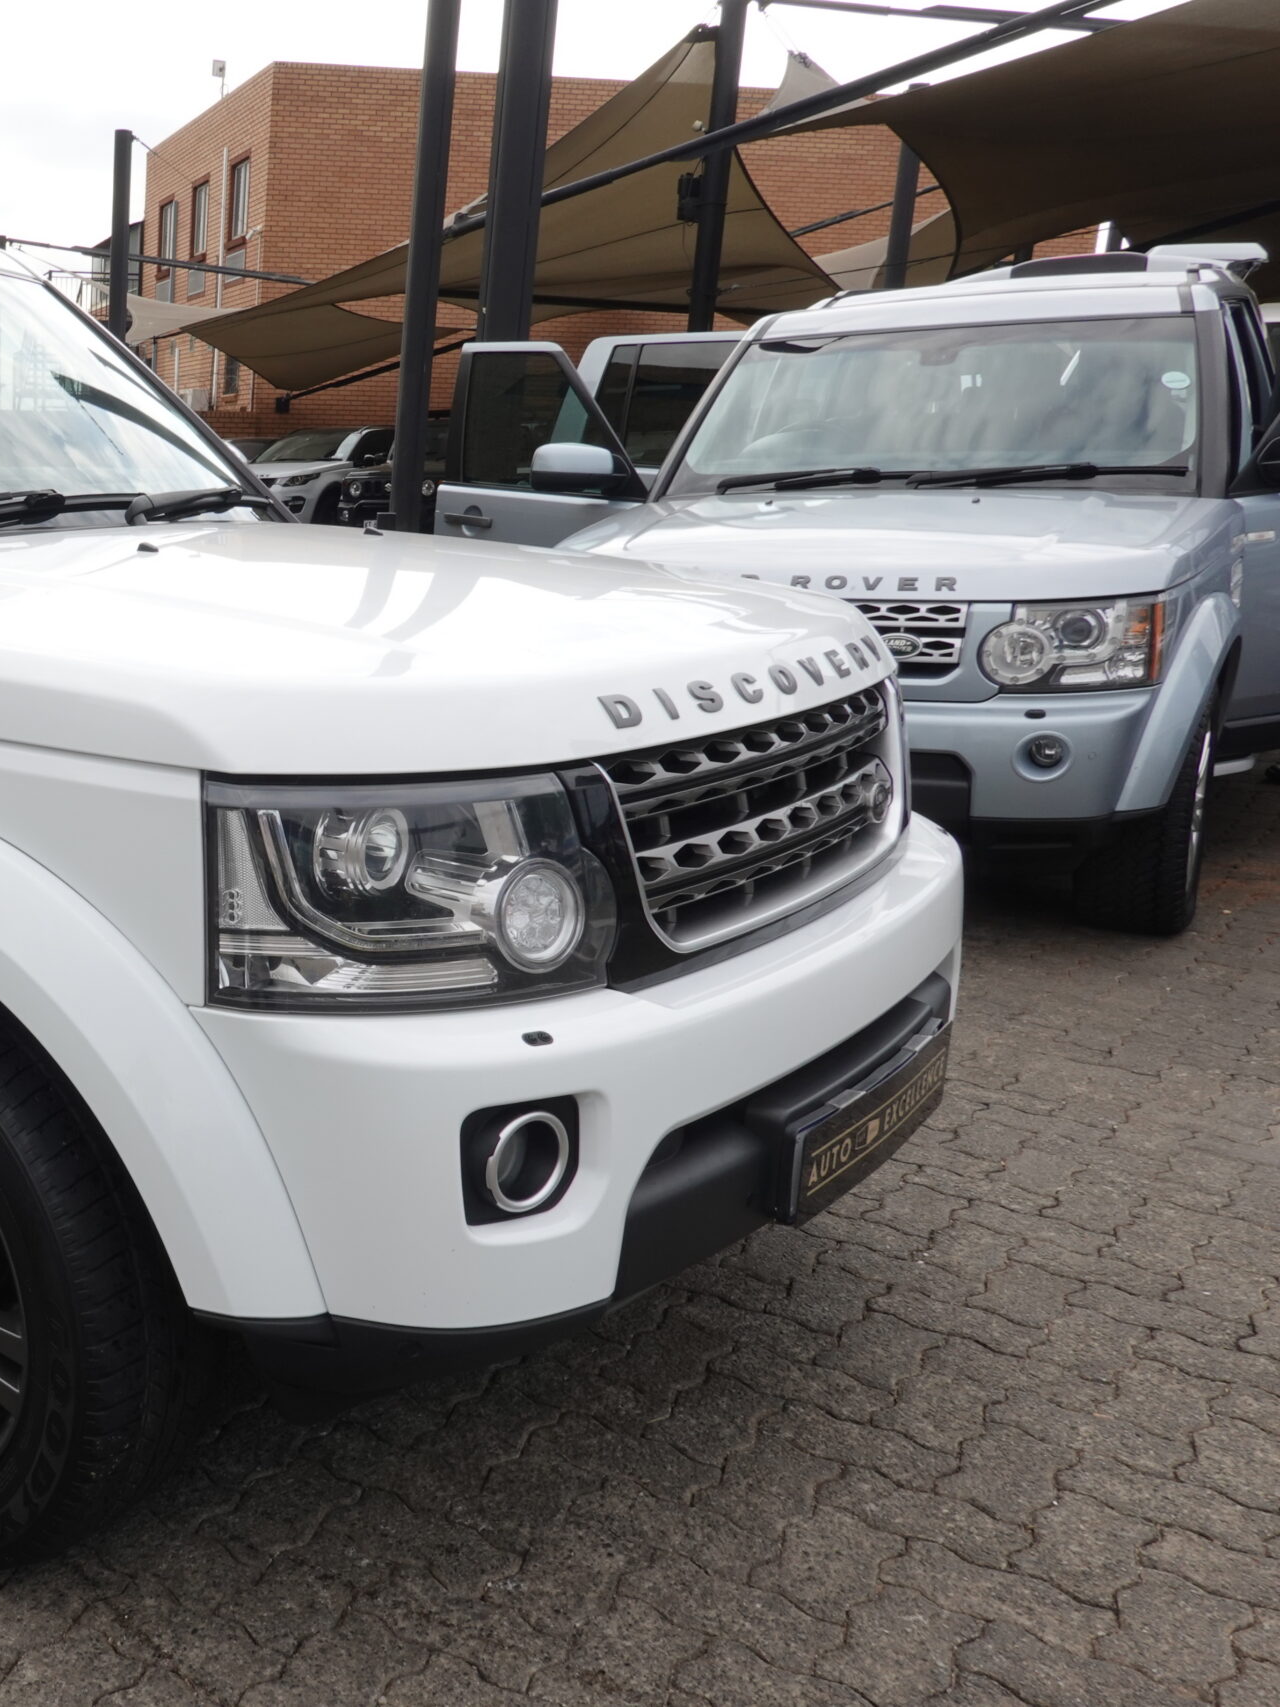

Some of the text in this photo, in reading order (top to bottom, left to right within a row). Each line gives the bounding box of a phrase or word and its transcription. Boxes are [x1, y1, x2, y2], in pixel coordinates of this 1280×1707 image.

[790, 575, 958, 592] ROVER
[597, 635, 883, 730] DISCOVERY
[808, 1055, 946, 1187] AUTO EXCELLENCE
